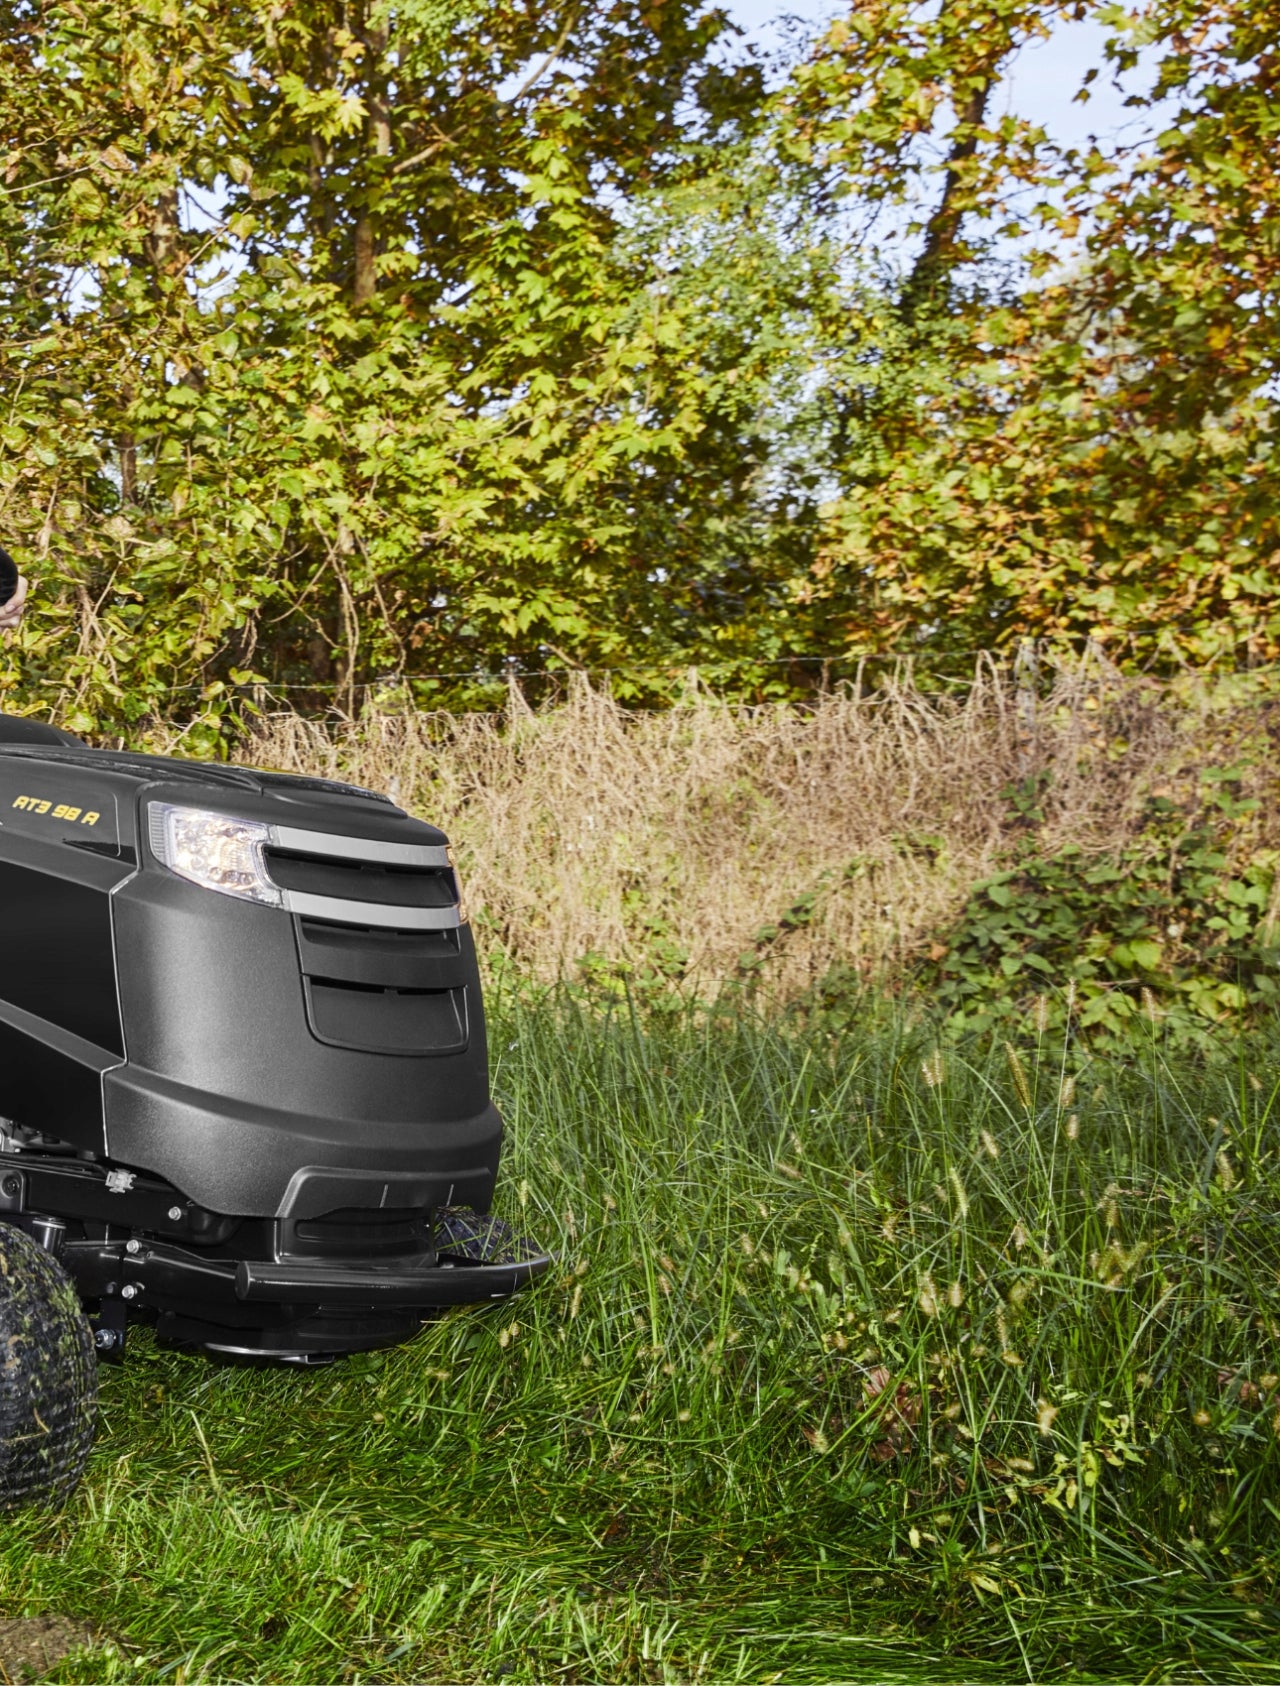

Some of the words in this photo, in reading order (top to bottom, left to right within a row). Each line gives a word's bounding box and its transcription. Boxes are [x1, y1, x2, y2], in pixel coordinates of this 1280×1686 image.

[12, 795, 52, 814] AT3
[51, 804, 82, 821] 98
[81, 811, 100, 826] A
